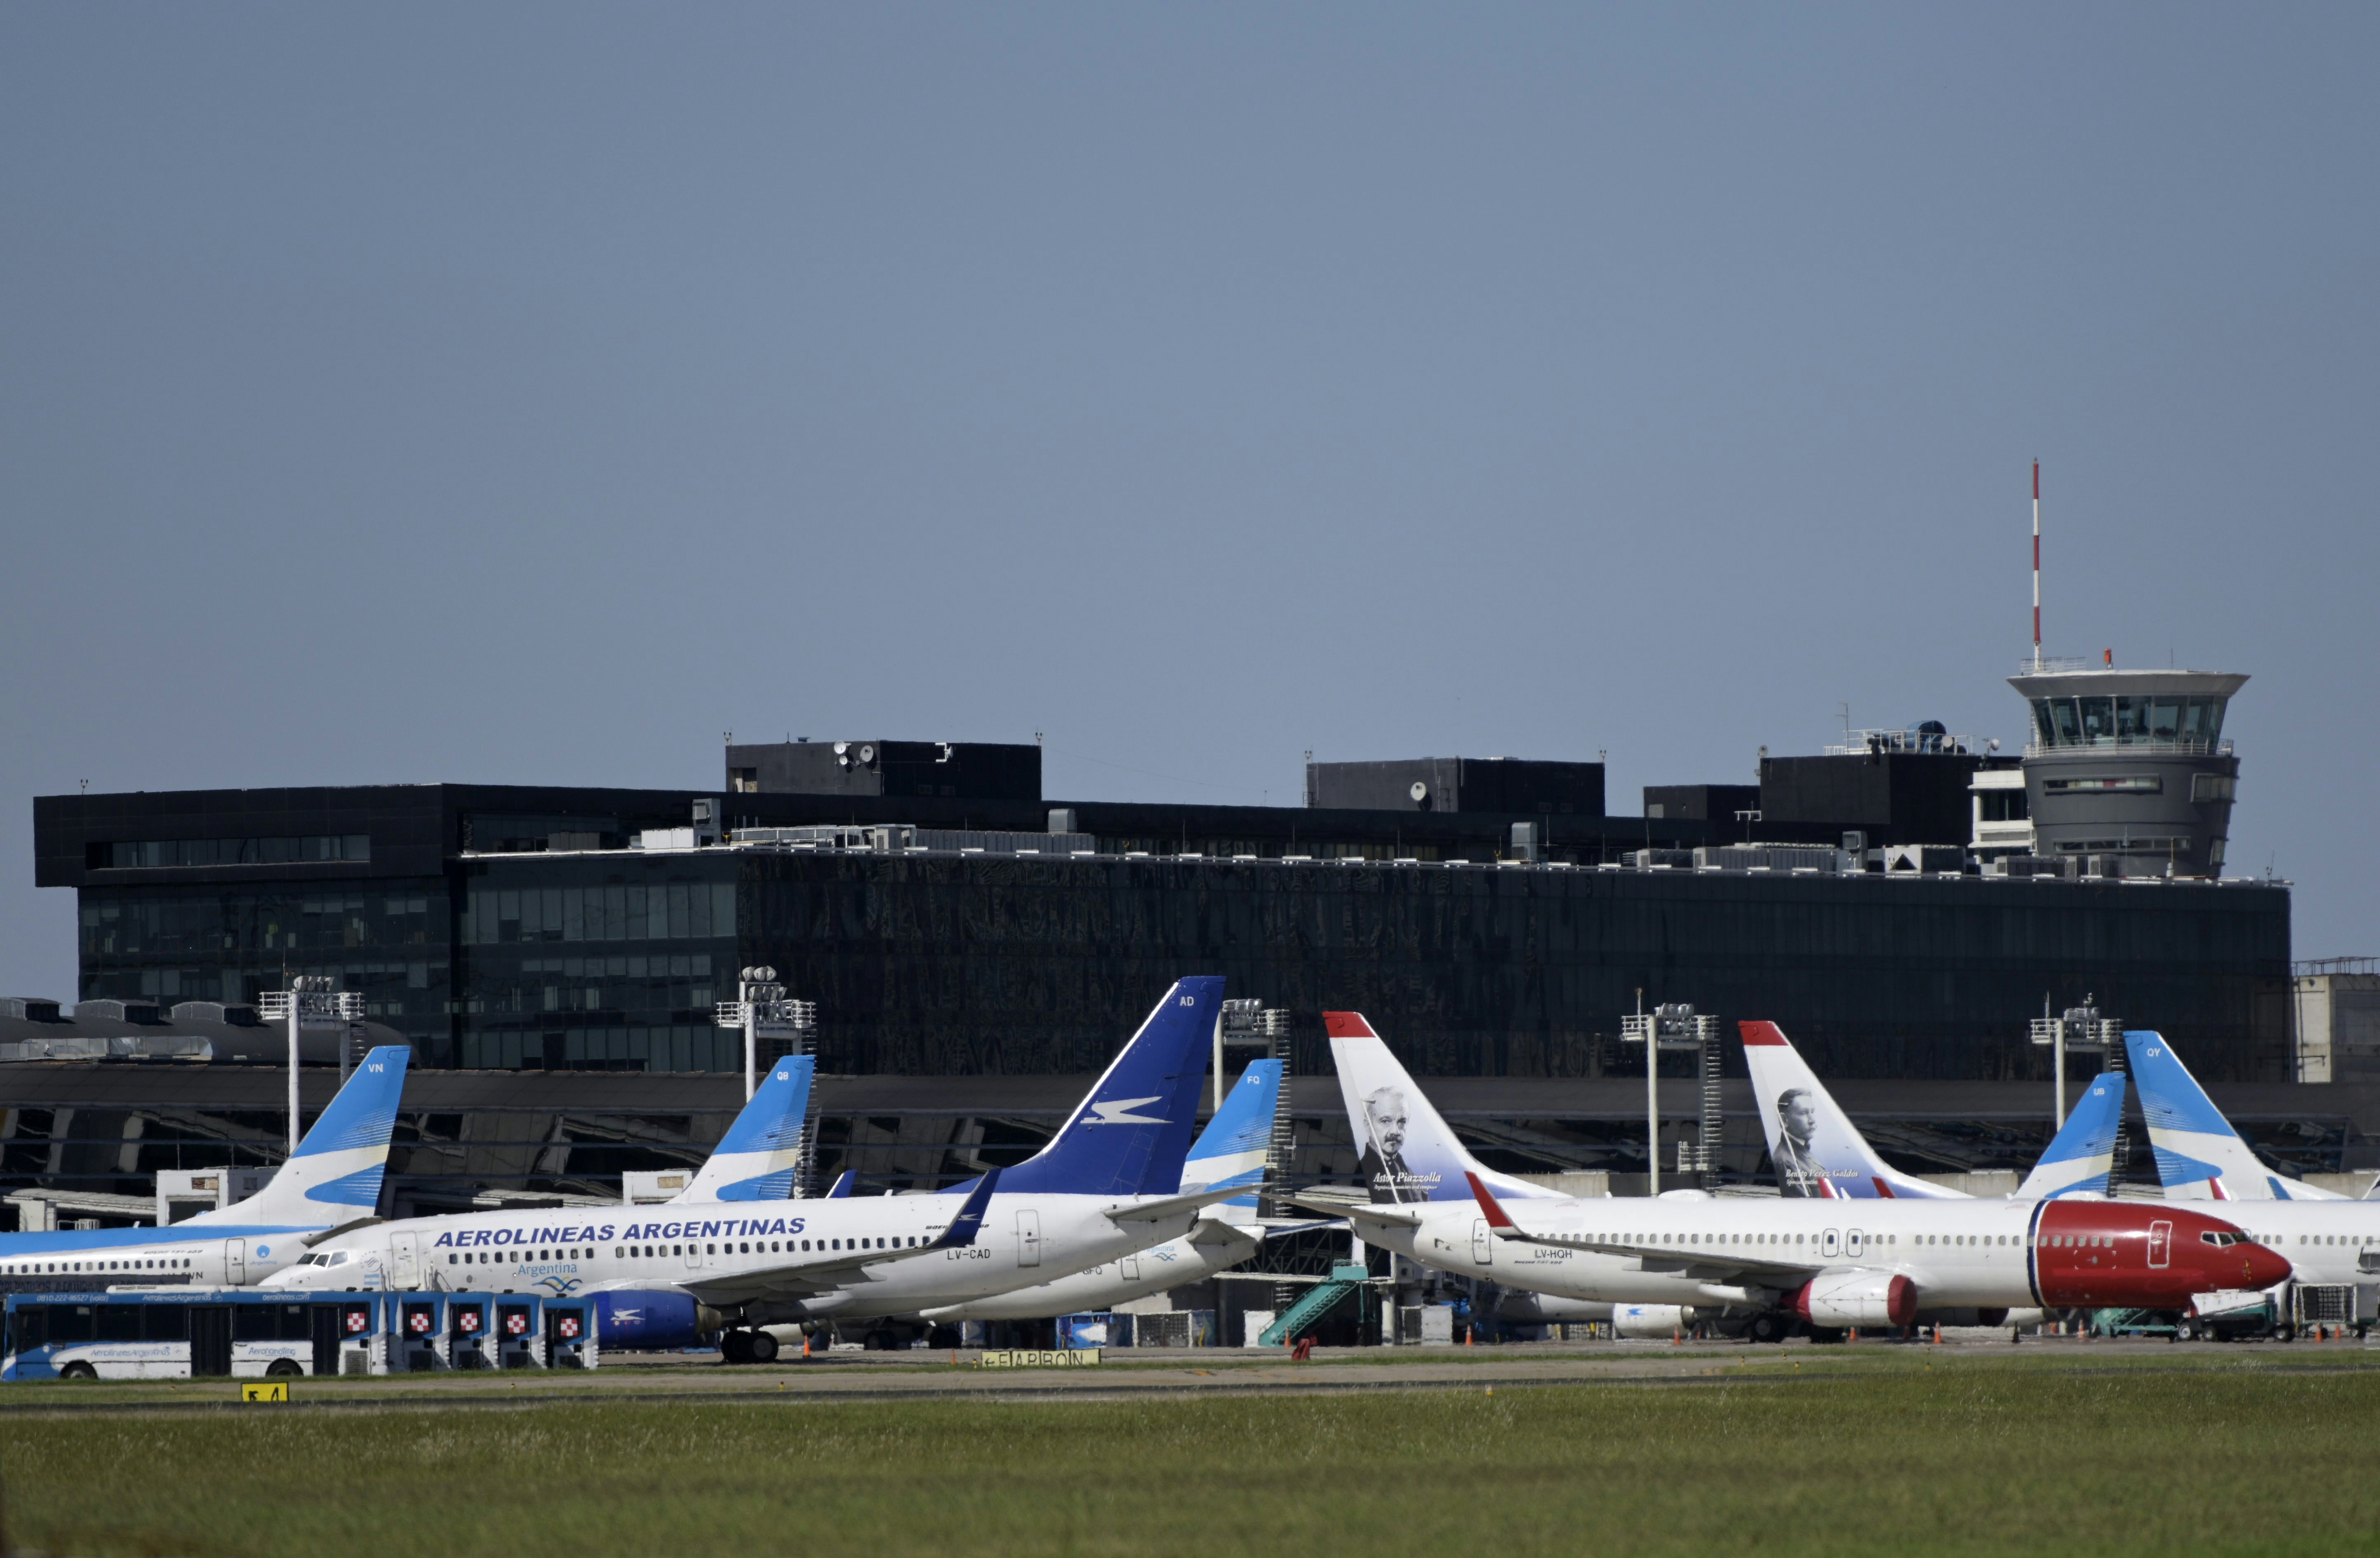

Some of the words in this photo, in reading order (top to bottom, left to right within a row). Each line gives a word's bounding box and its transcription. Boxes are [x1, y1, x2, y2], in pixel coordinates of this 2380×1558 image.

[1180, 996, 1194, 1006] AD
[2147, 1047, 2161, 1057] QY
[368, 1064, 383, 1073] VN
[1247, 1076, 1260, 1084] FQ
[1396, 1171, 1442, 1182] Piazzolla
[434, 1224, 615, 1247] AEROLINEAS
[622, 1218, 806, 1240] ARGENTINAS
[947, 1249, 990, 1260] LV-CAD
[1535, 1249, 1572, 1259] LV-HQH
[518, 1262, 577, 1278] Argentina
[248, 1347, 296, 1356] Aerohandling
[1016, 1352, 1083, 1366] APRON
